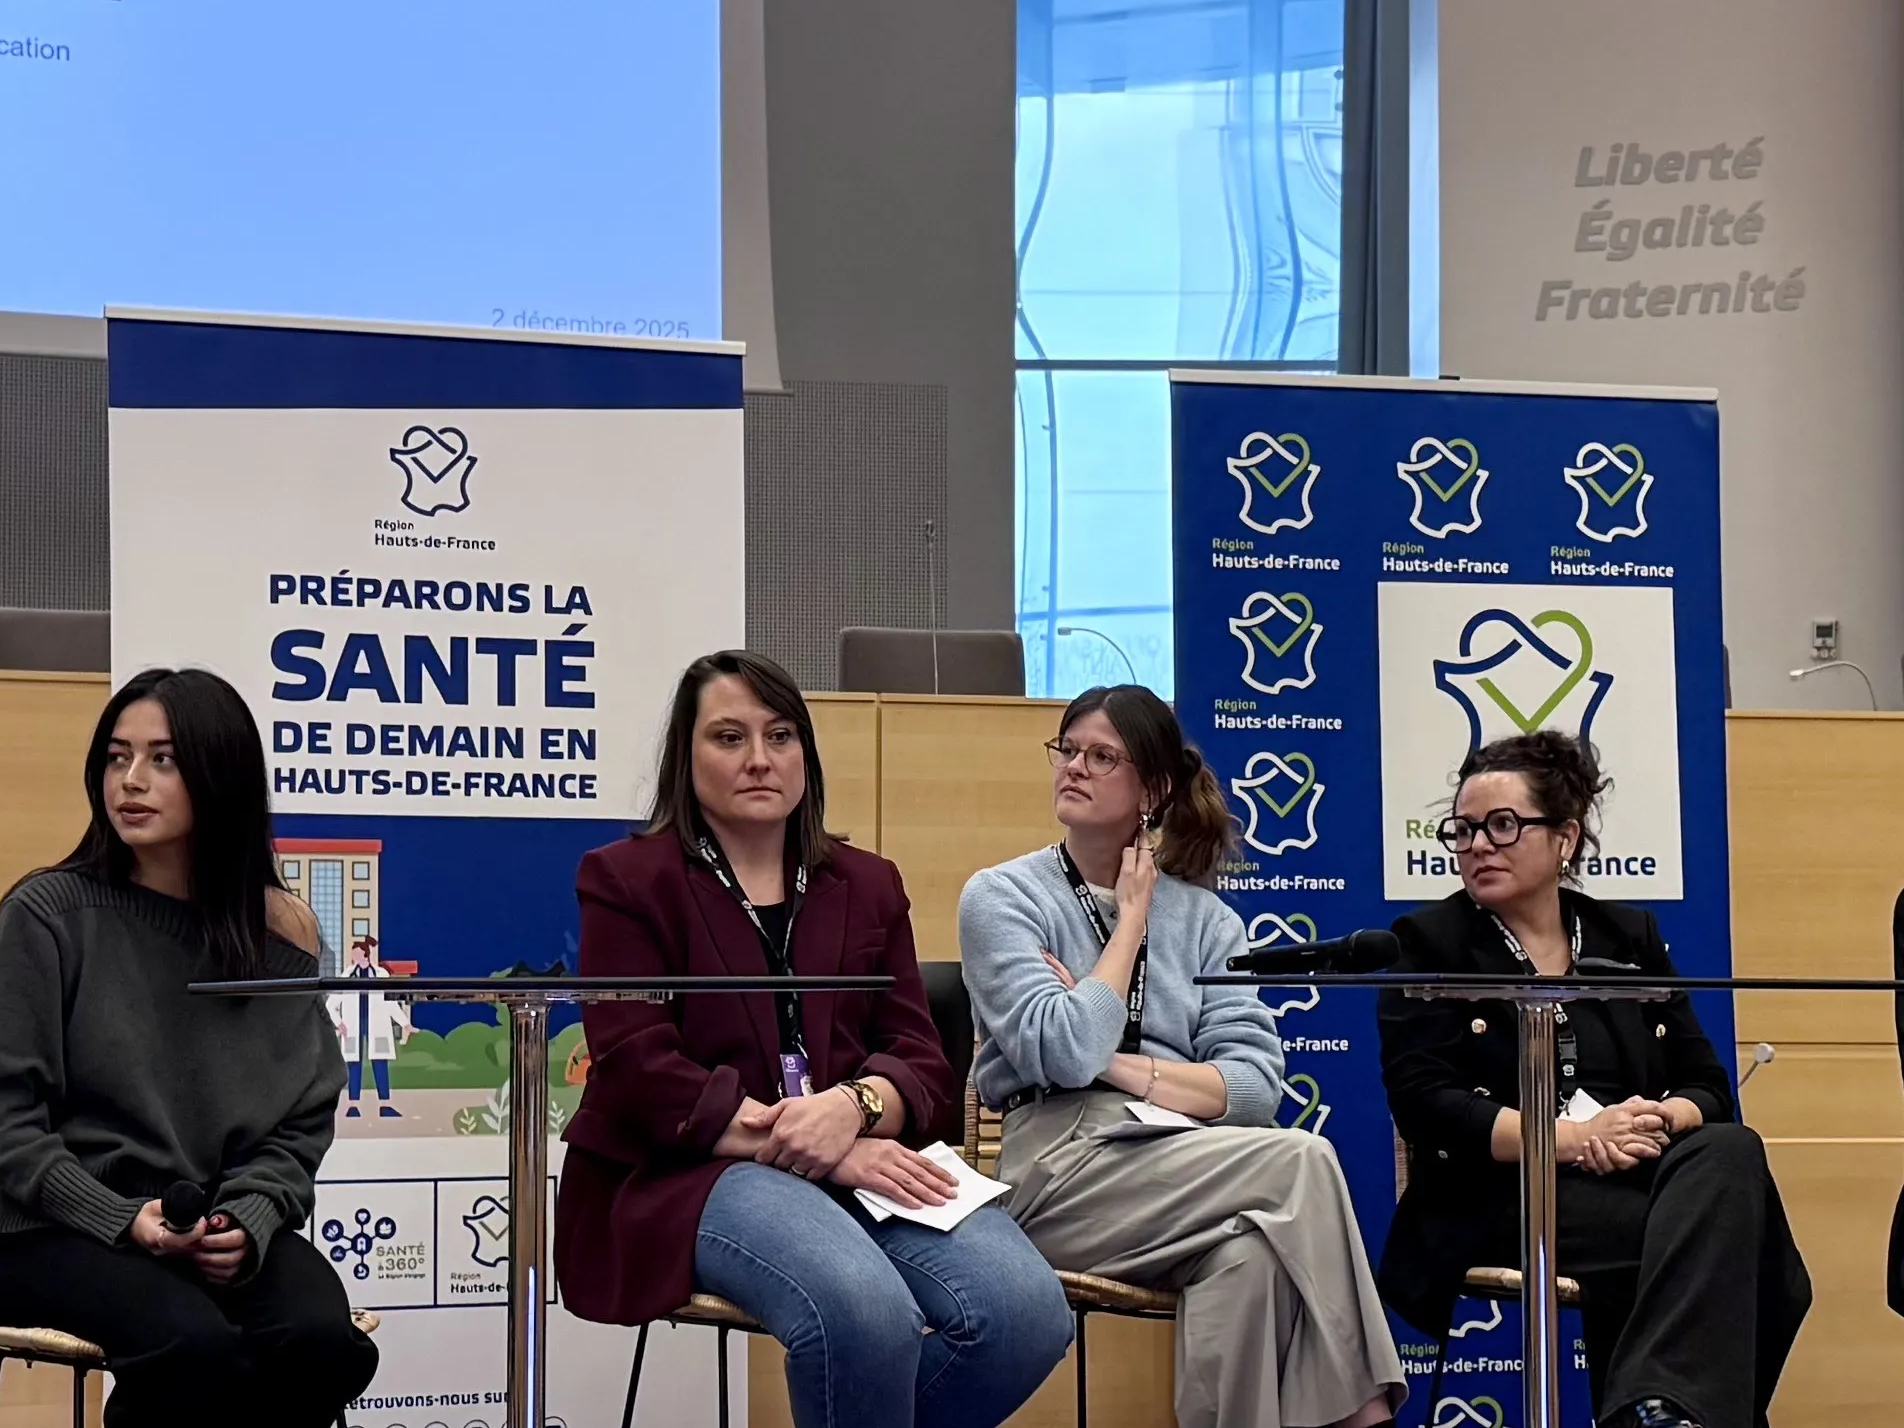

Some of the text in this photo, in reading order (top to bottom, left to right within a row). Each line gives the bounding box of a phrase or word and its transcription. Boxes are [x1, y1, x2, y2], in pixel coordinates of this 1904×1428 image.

[1574, 135, 1765, 188] Liberté
[1574, 198, 1765, 261] Égalité
[1535, 266, 1806, 321] Fraternité
[513, 309, 626, 335] décembre
[375, 519, 414, 533] Région
[375, 533, 496, 551] Hauts-de-France
[1212, 538, 1254, 553] Région
[1382, 541, 1424, 556] Région
[1550, 545, 1591, 559] Région
[1212, 553, 1340, 572] Hauts-de-France
[1382, 557, 1509, 575] Hauts-de-France
[1550, 560, 1674, 579] Hauts-de-France
[269, 569, 593, 617] PRÉPARONS LA
[270, 623, 596, 709] SANTÉ
[1215, 698, 1257, 712] Région
[1215, 714, 1343, 730] Hauts-de-France
[273, 720, 596, 761] DE DEMAIN EN
[274, 768, 597, 800] HAUTS-DE-FRANCE
[1217, 875, 1345, 891] Hauts-de-France
[1281, 1035, 1349, 1052] e-France
[376, 1242, 425, 1257] SANTÉ
[385, 1258, 425, 1271] 360°
[450, 1282, 509, 1294] Hauts-de-
[345, 1392, 479, 1410] etrouvons-nous
